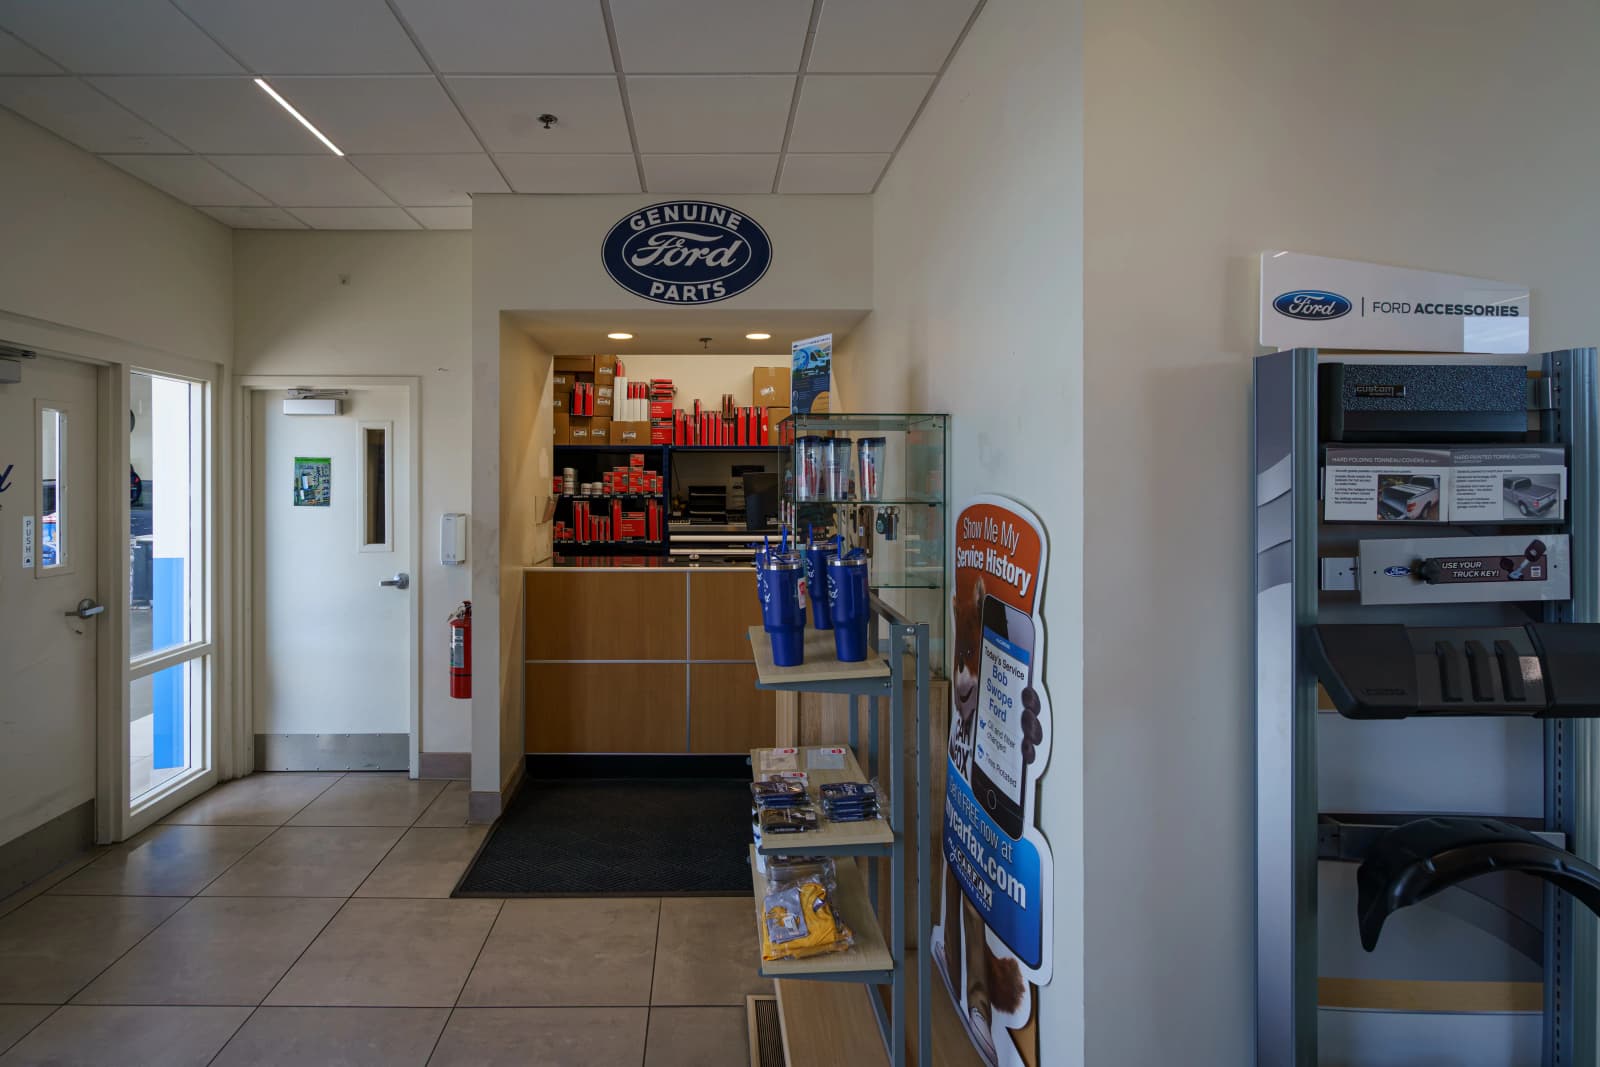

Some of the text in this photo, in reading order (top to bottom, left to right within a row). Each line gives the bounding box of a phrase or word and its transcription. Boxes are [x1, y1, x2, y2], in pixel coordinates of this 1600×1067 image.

[630, 205, 743, 231] GENUINE
[631, 231, 744, 267] Ford
[649, 281, 726, 301] PARTS
[1288, 295, 1335, 316] Ford
[1372, 301, 1519, 317] FORD ACCESSORIES
[963, 516, 1020, 556] Show Me My
[957, 544, 1032, 597] Service History
[1452, 569, 1500, 578] TRUCK KEY!
[1459, 561, 1482, 569] YOUR
[992, 664, 1008, 687] Bob
[1002, 659, 1025, 681] Service
[986, 678, 1013, 708] Swope
[988, 698, 1007, 723] Ford
[962, 792, 980, 822] FREE
[980, 820, 999, 849] now
[1001, 840, 1014, 864] at
[957, 850, 993, 906] CARFAX
